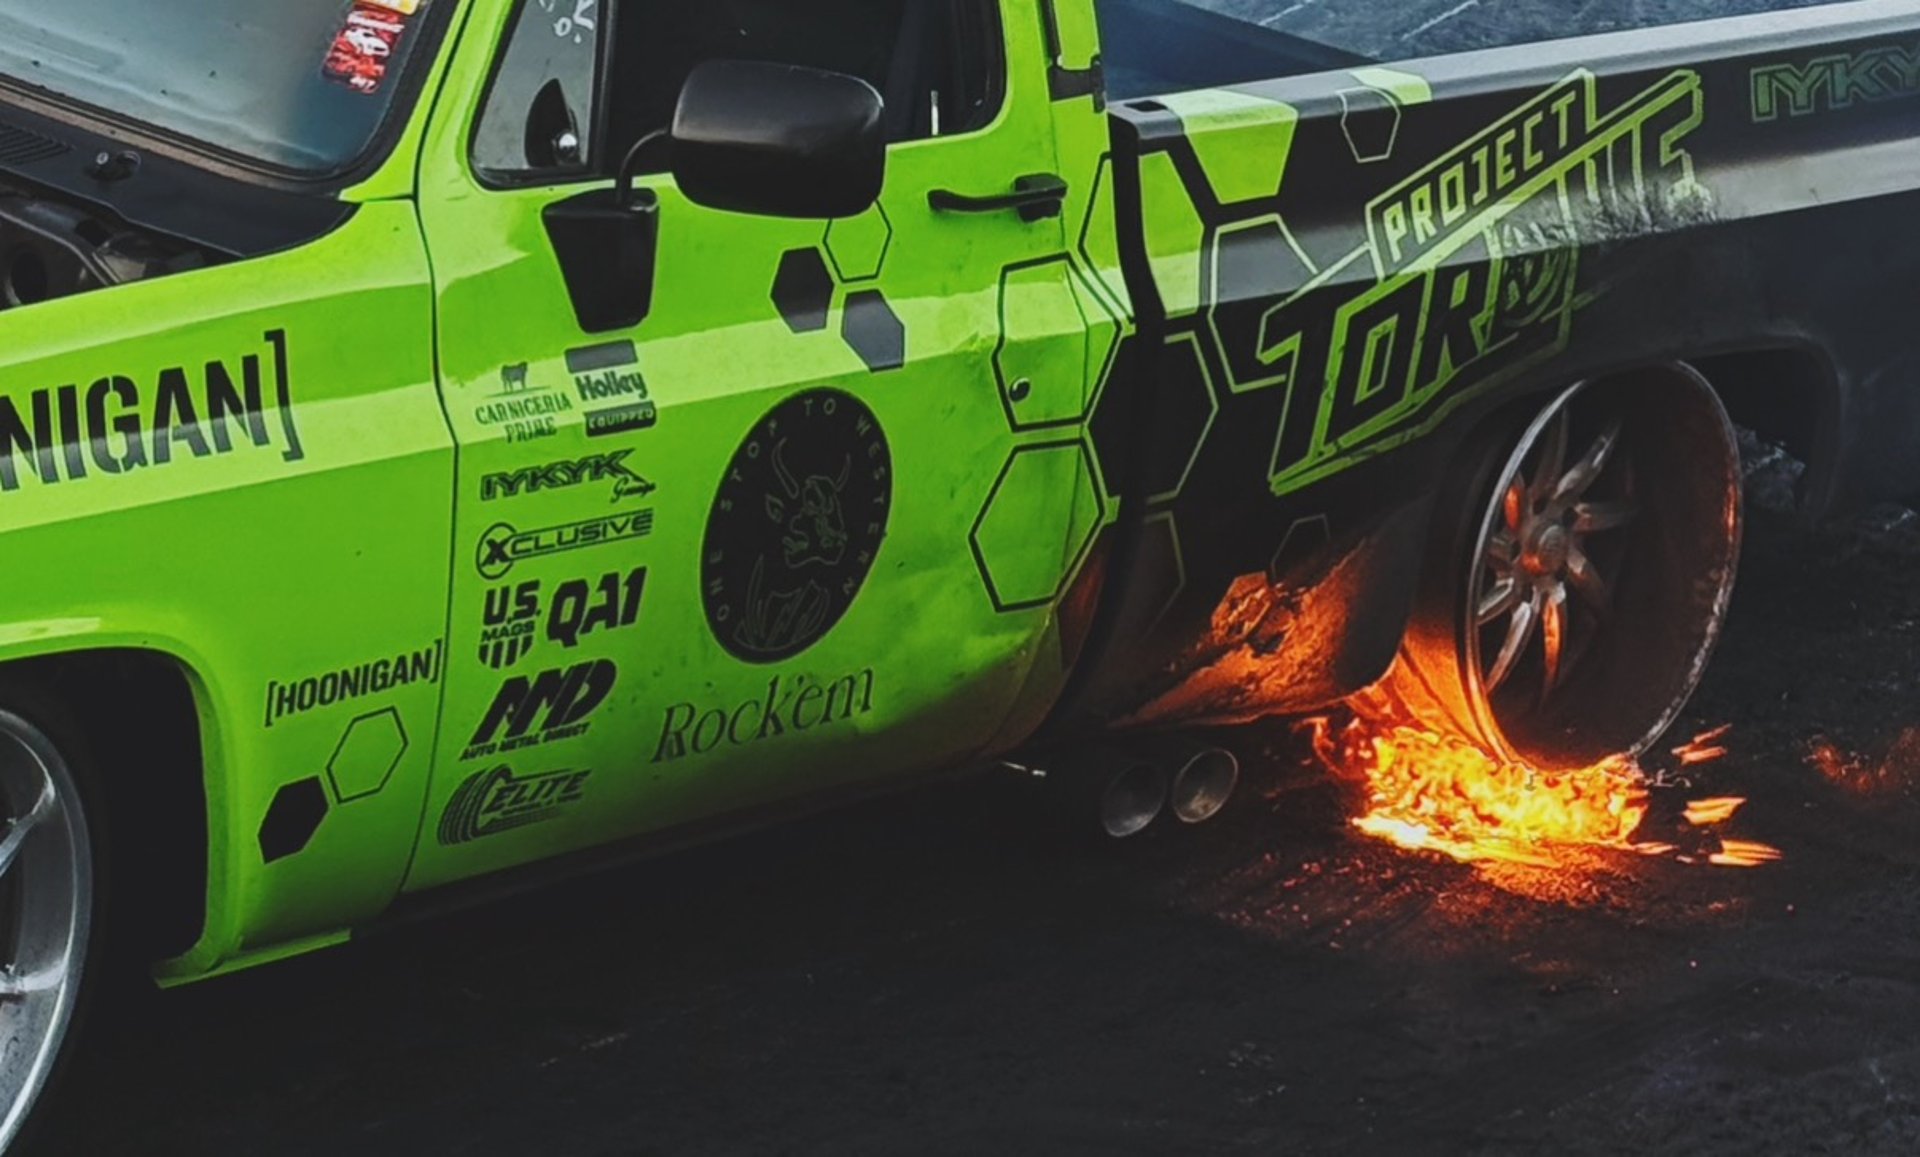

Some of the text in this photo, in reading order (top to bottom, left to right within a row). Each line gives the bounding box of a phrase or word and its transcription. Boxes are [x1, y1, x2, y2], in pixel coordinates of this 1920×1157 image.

[1381, 90, 1577, 263] PROJECT
[475, 391, 574, 426] CARNICERIA
[575, 370, 649, 402] Holley
[803, 398, 837, 417] TO
[588, 408, 655, 430] EQUIPPED
[480, 447, 650, 502] IYKYK
[477, 510, 655, 576] XCLUSIVE
[483, 578, 542, 626] U.S.
[546, 565, 648, 649] QA1
[264, 638, 443, 728] [HOONIGAN]
[482, 767, 593, 816] ELITE
